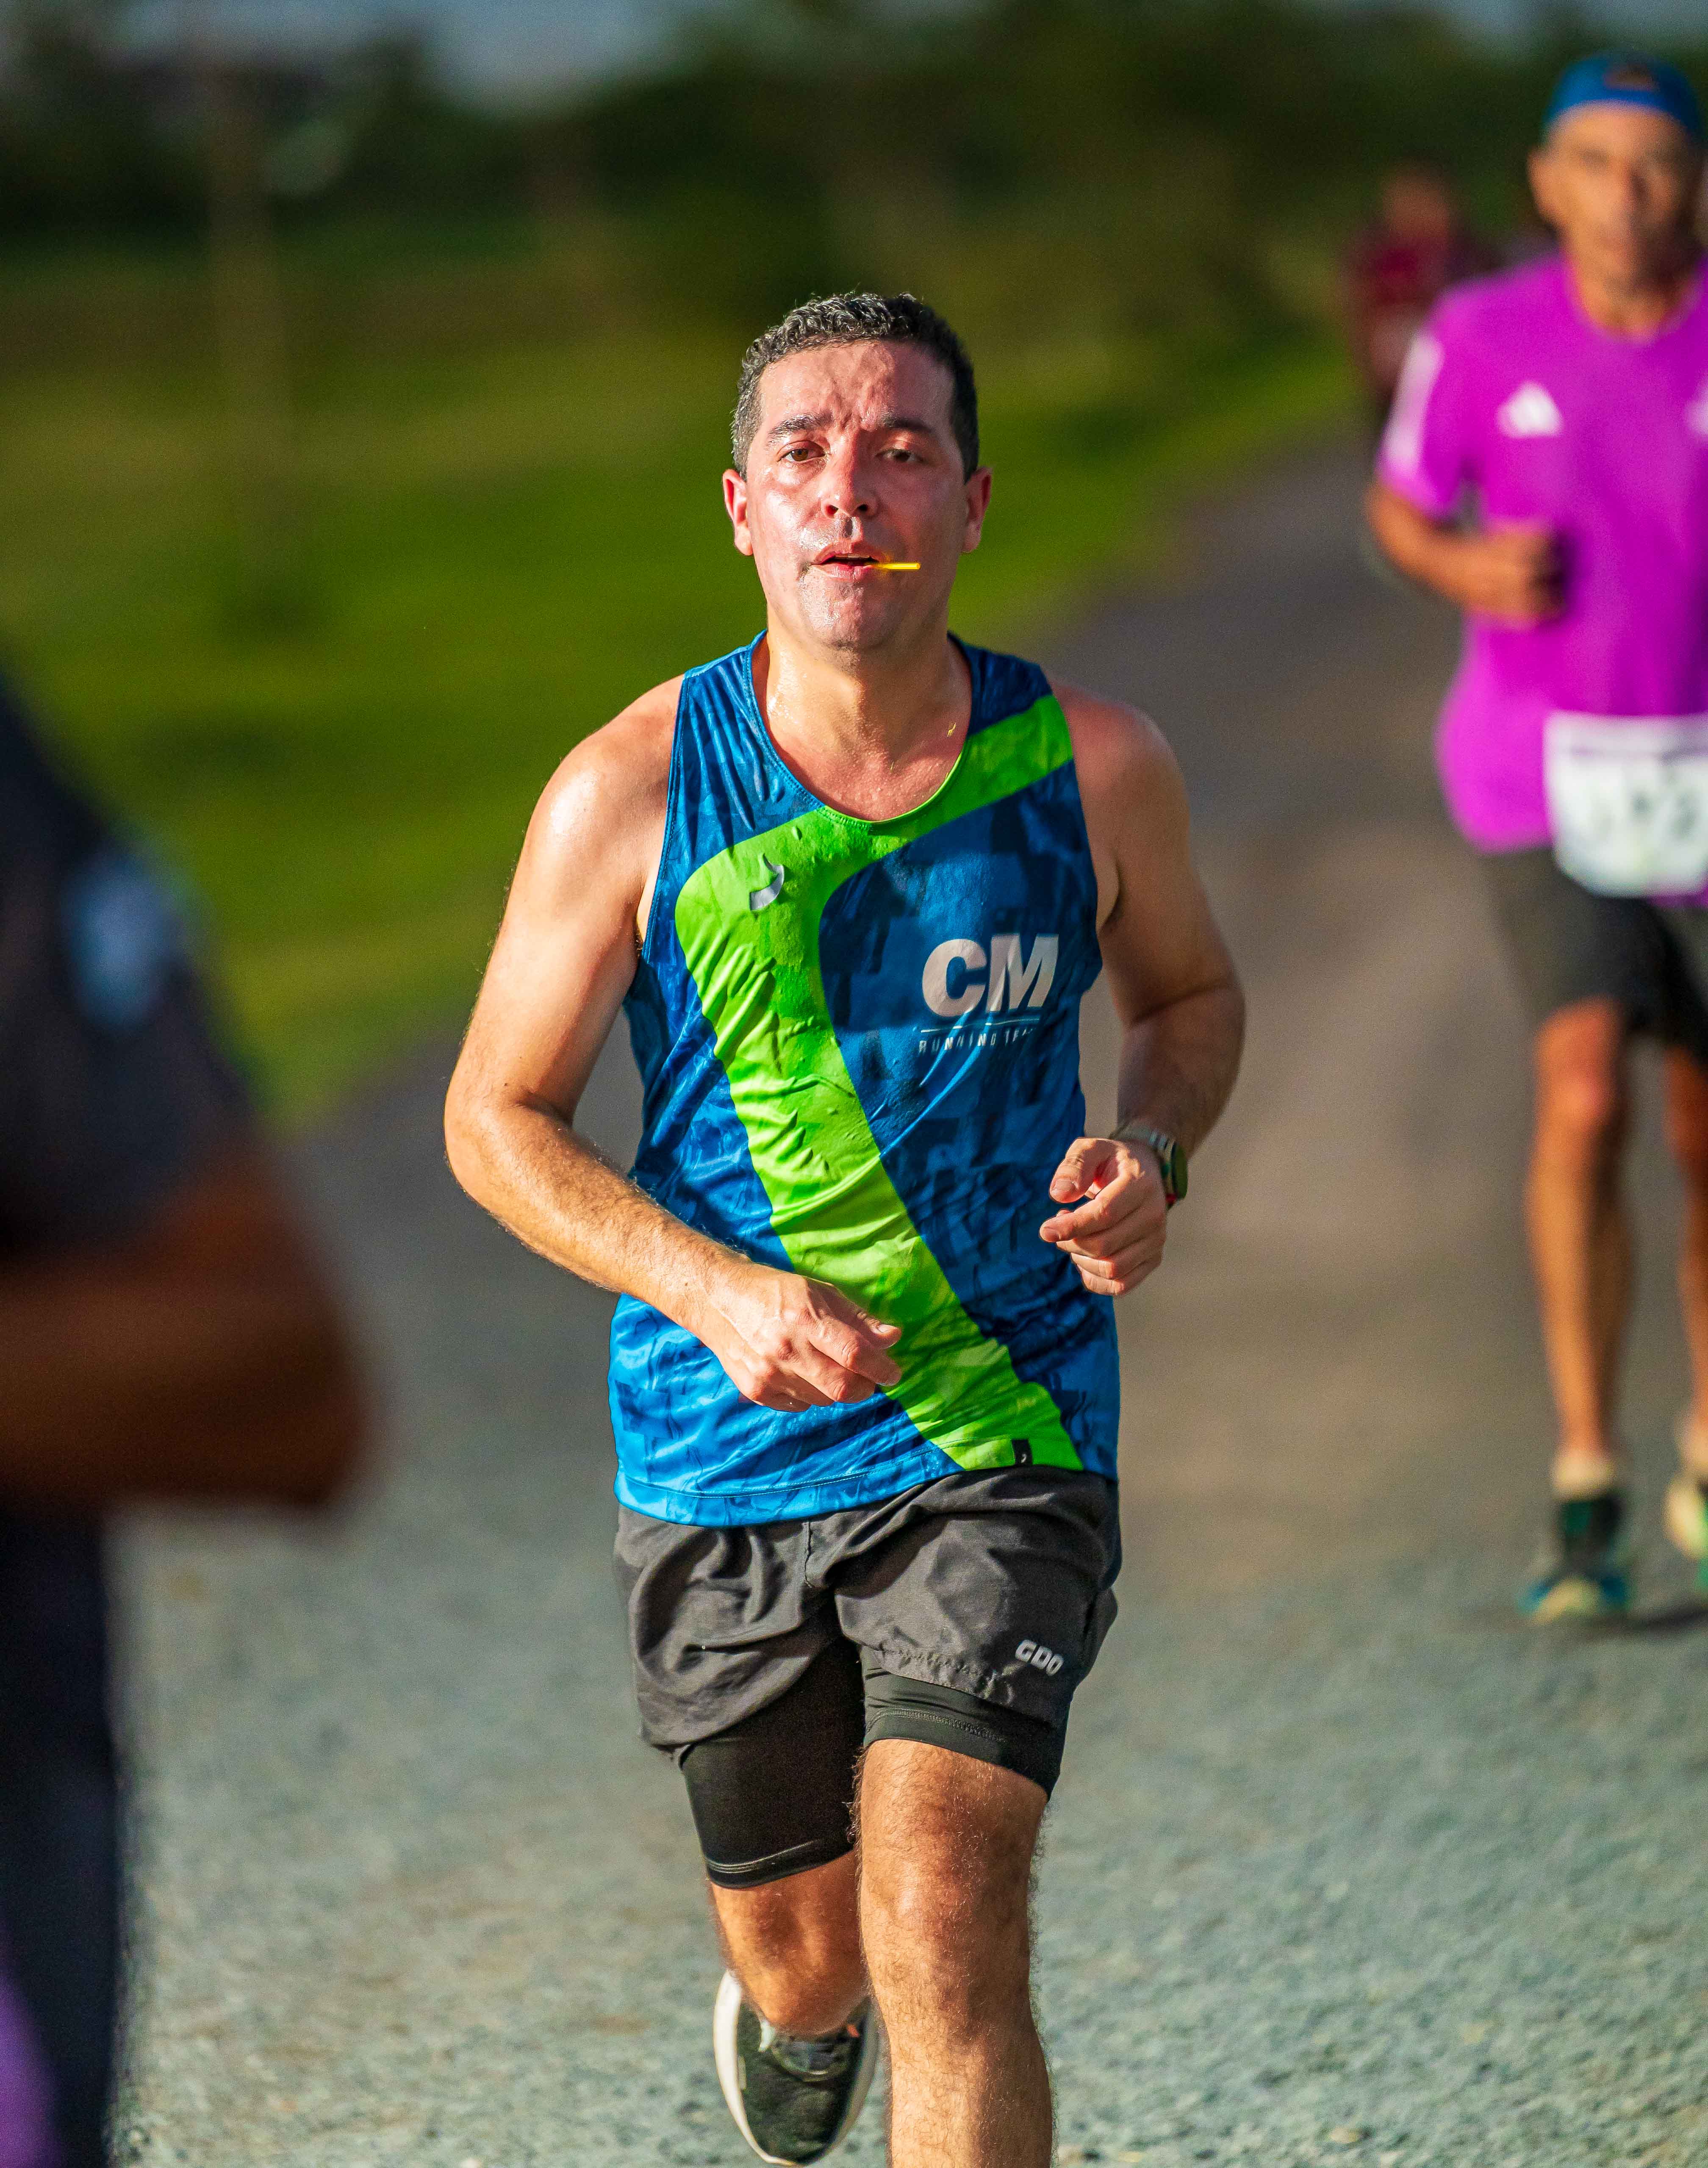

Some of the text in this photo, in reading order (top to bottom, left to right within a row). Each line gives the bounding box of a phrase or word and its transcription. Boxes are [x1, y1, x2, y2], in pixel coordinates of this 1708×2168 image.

[922, 933, 1059, 1017] CM
[918, 1033, 997, 1054] RUNNING
[1015, 1639, 1064, 1676] GDO
